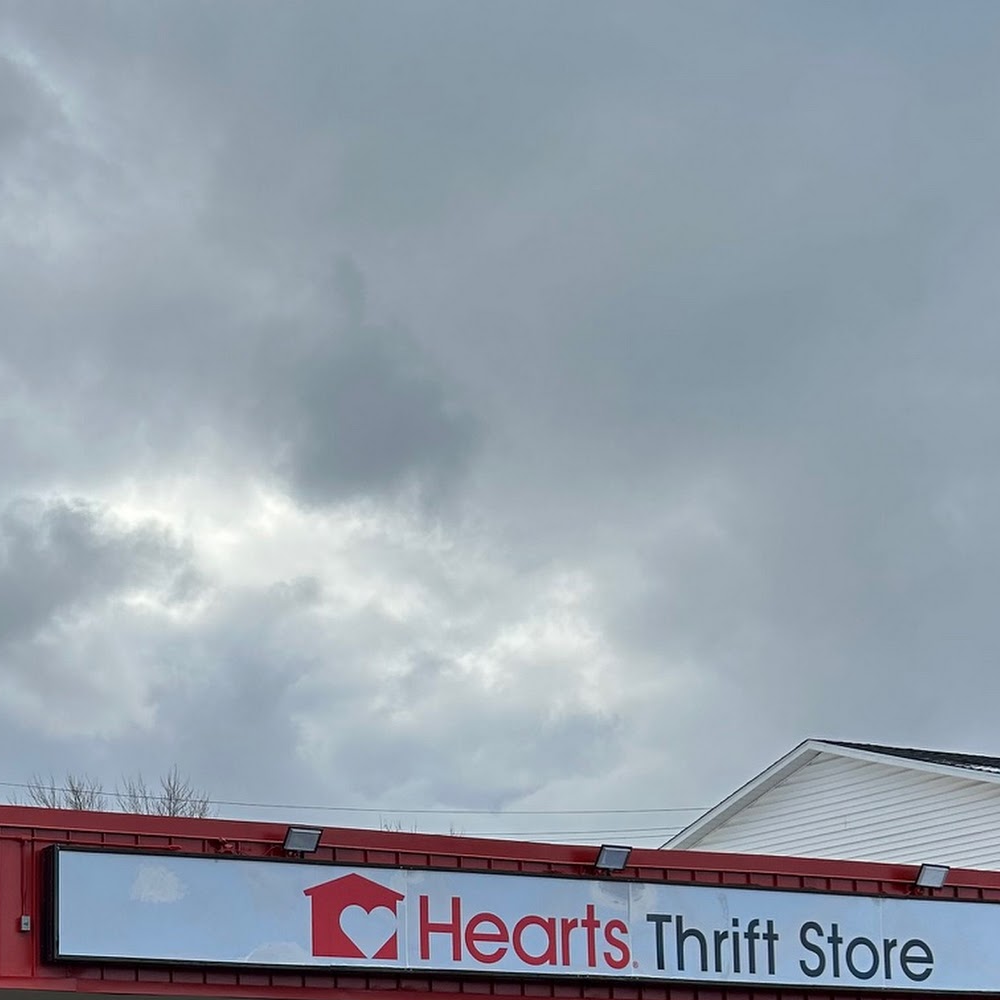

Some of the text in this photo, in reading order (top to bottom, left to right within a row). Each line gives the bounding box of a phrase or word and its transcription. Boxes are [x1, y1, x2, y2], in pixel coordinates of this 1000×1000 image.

[419, 894, 935, 982] Hearts Thrift Store
